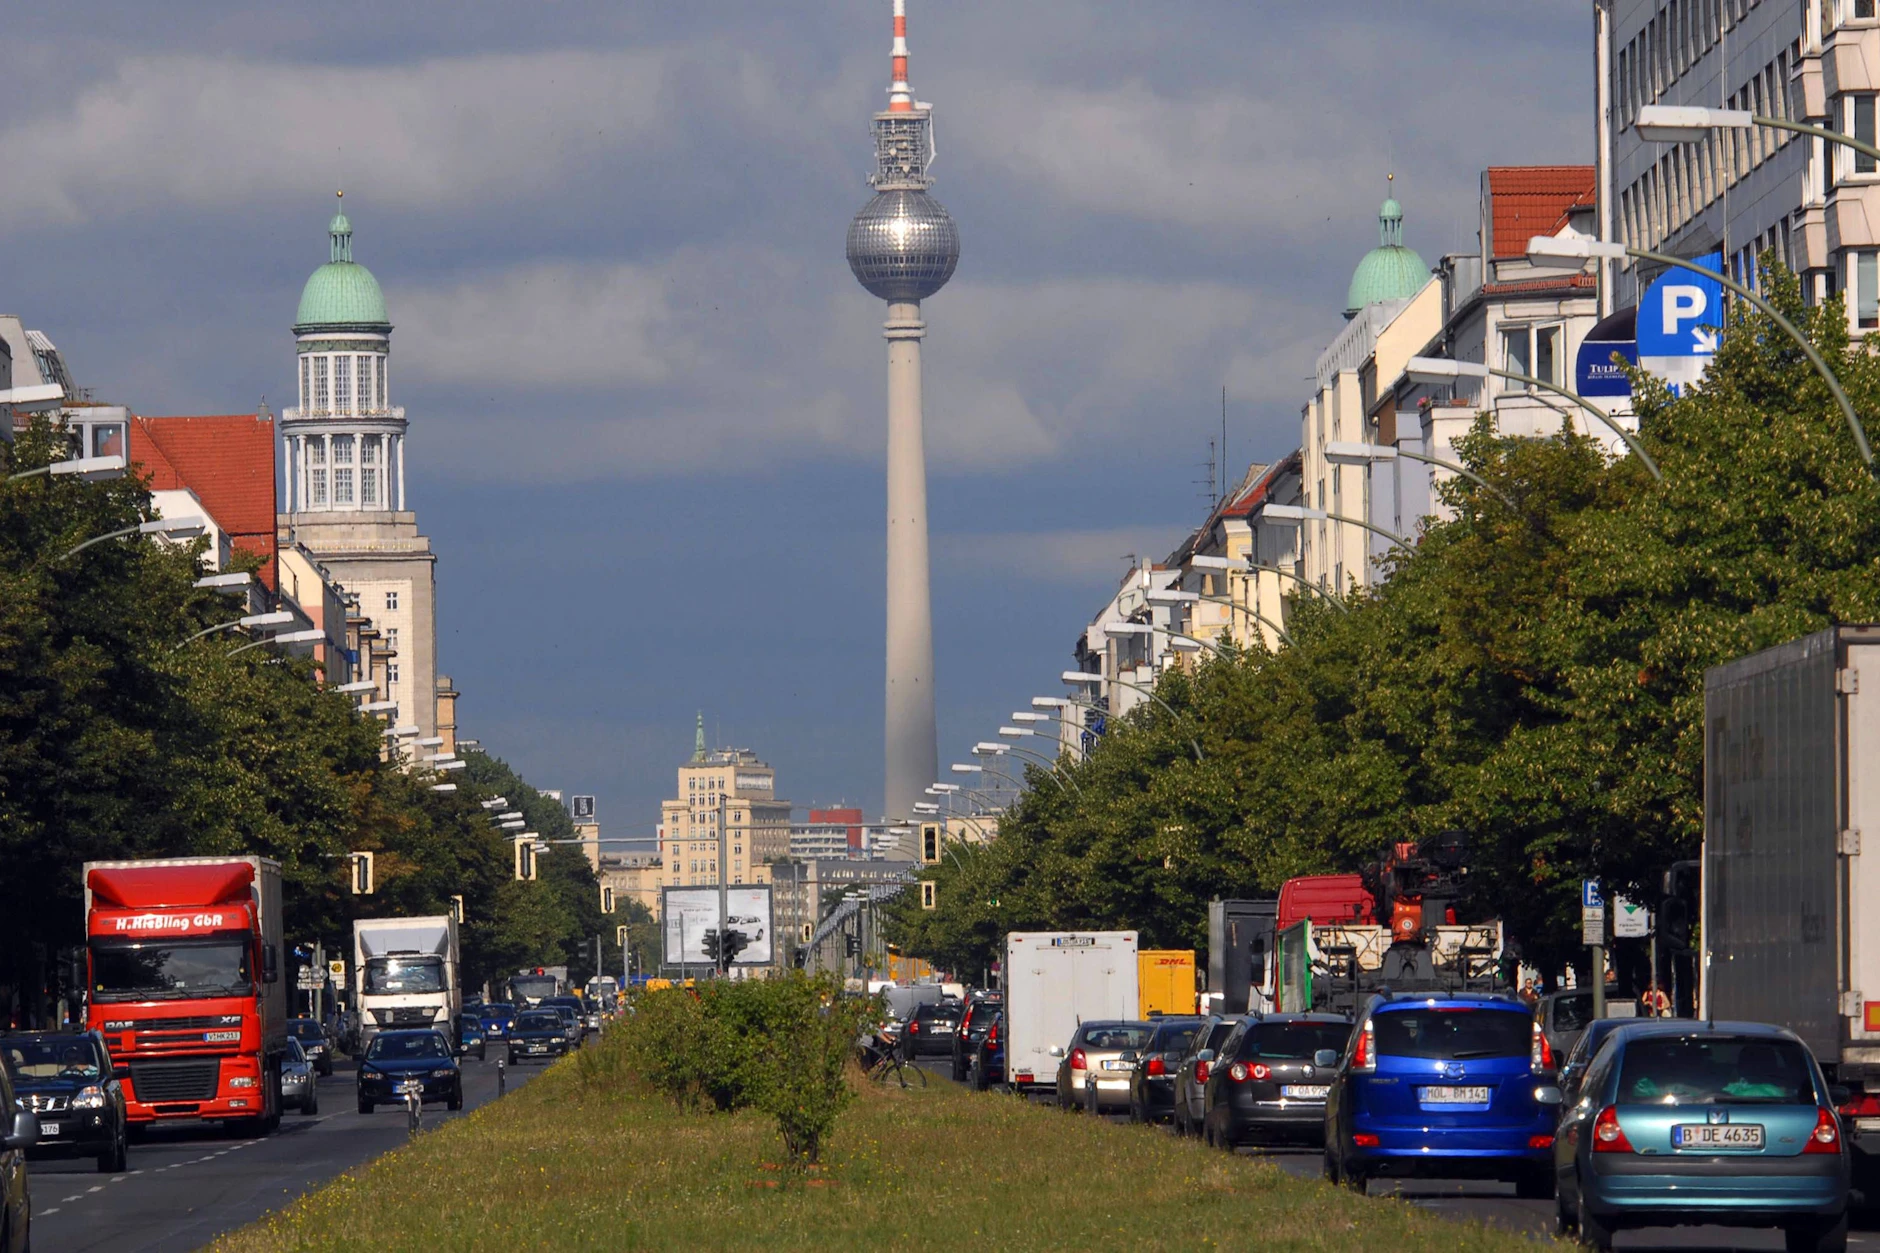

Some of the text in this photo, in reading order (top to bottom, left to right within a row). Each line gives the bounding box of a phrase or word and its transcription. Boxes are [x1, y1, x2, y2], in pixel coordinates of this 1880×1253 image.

[1662, 285, 1707, 334] P
[193, 914, 223, 927] GbR
[105, 1021, 134, 1029] DAF
[221, 1016, 241, 1024] XF
[1427, 1088, 1446, 1099] MOL
[1468, 1087, 1487, 1099] 141
[1683, 1128, 1759, 1142] B DE 4635
